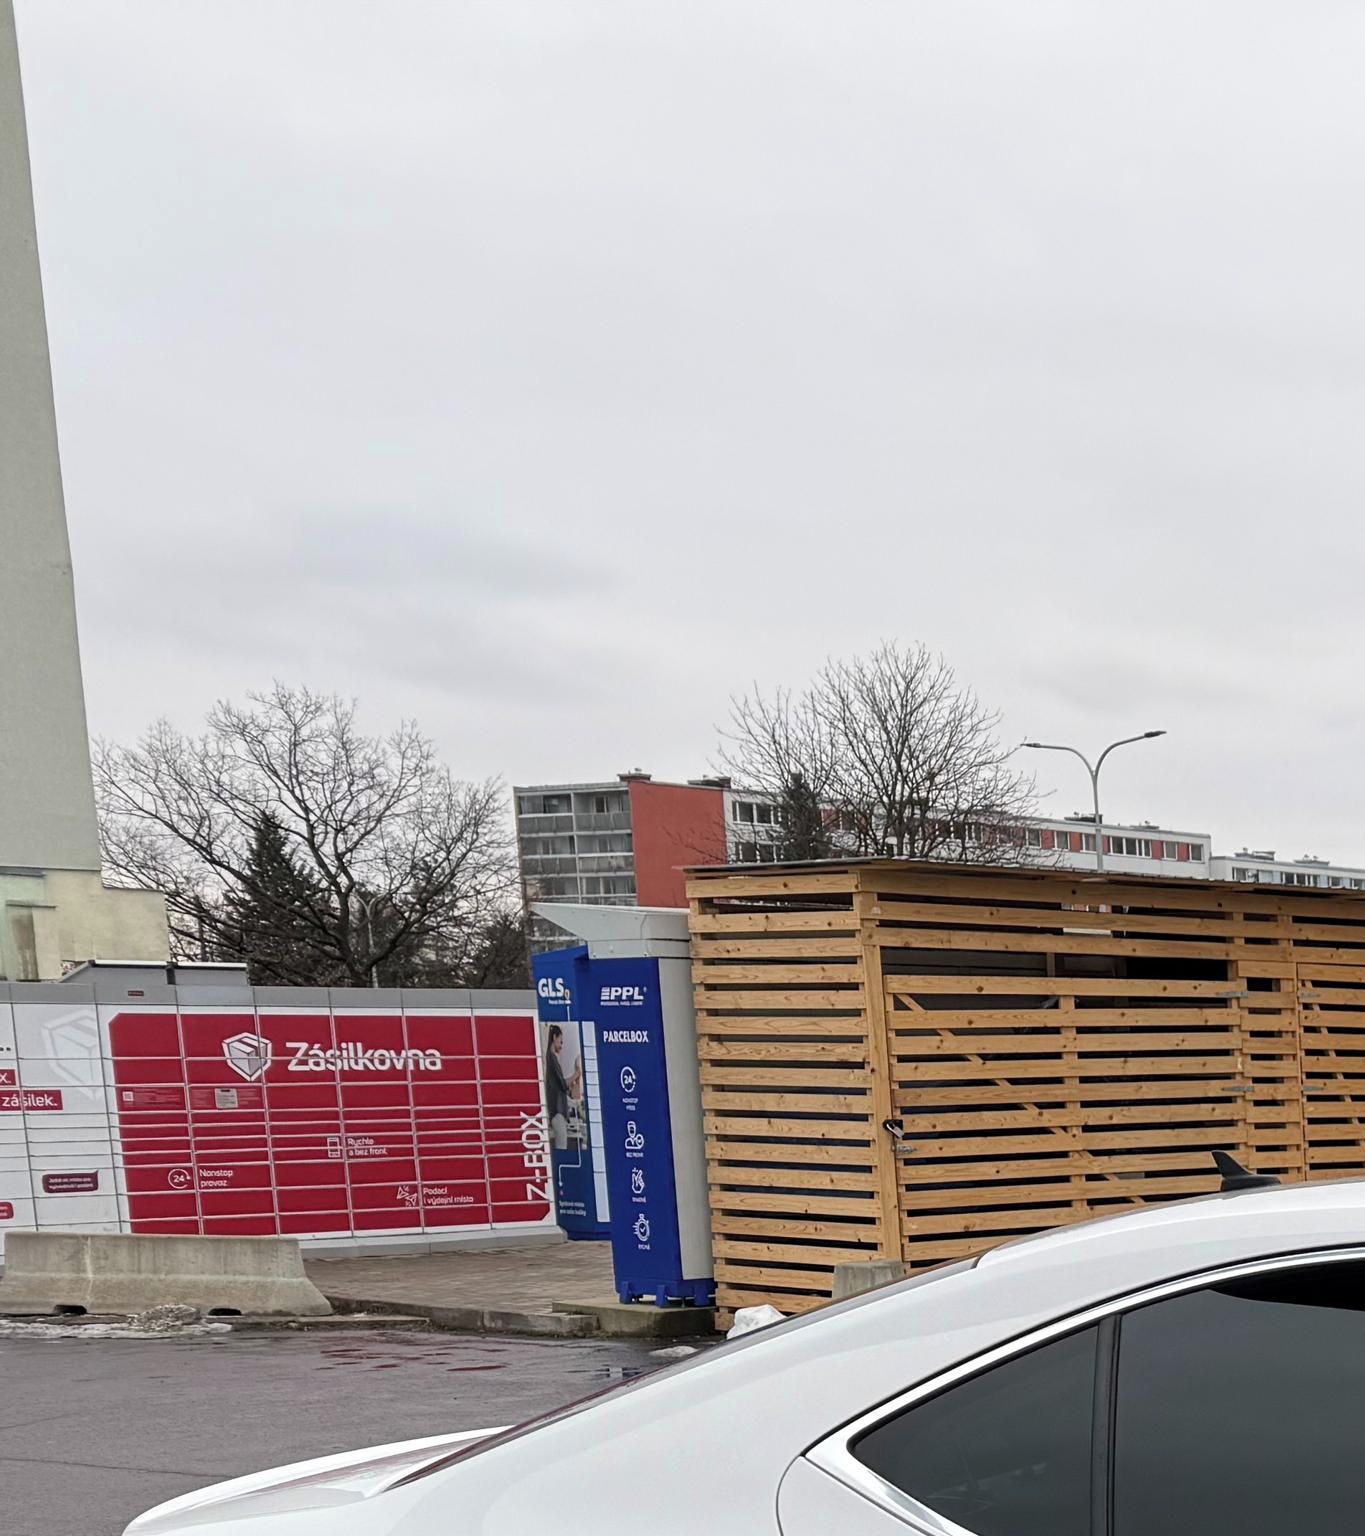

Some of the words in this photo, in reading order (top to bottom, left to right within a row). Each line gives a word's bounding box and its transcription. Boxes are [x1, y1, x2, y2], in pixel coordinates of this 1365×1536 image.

[538, 977, 564, 997] GLS
[609, 987, 644, 1000] PPL
[603, 1030, 648, 1042] PARCELBOX
[286, 1042, 442, 1071] Zásilkovna
[520, 1111, 549, 1200] Z-BOX
[173, 1174, 185, 1183] 24
[199, 1168, 233, 1178] Nonstop
